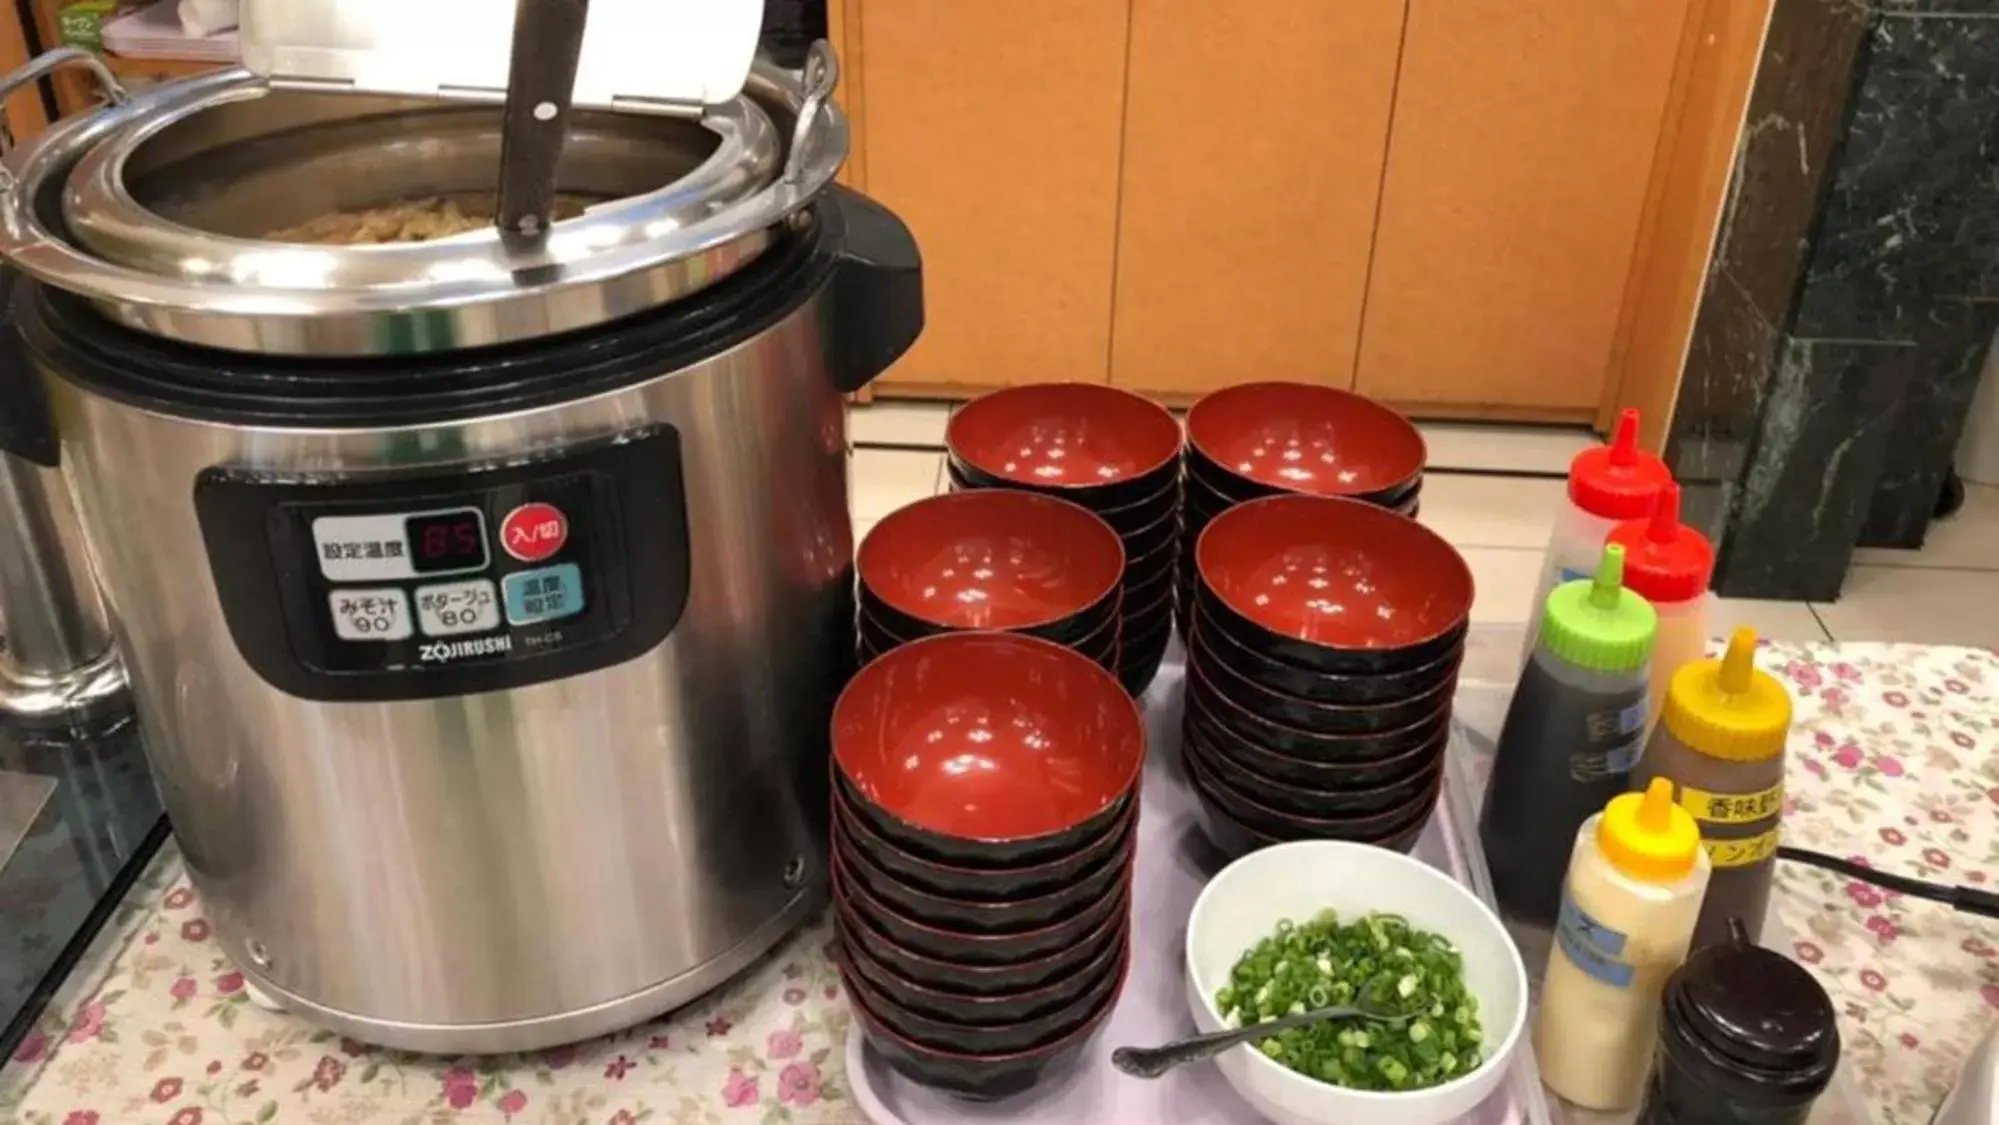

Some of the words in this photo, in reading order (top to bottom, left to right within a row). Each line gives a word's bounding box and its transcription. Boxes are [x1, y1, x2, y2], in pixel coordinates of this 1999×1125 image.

[424, 521, 477, 558] 85
[511, 520, 559, 545] 入/切
[323, 540, 404, 560] 設定温度
[340, 597, 397, 615] みそ汁
[421, 588, 491, 611] ポタージュ
[353, 616, 390, 633] 90
[441, 608, 478, 627] 80
[419, 635, 512, 663] ZOJIRUSHI
